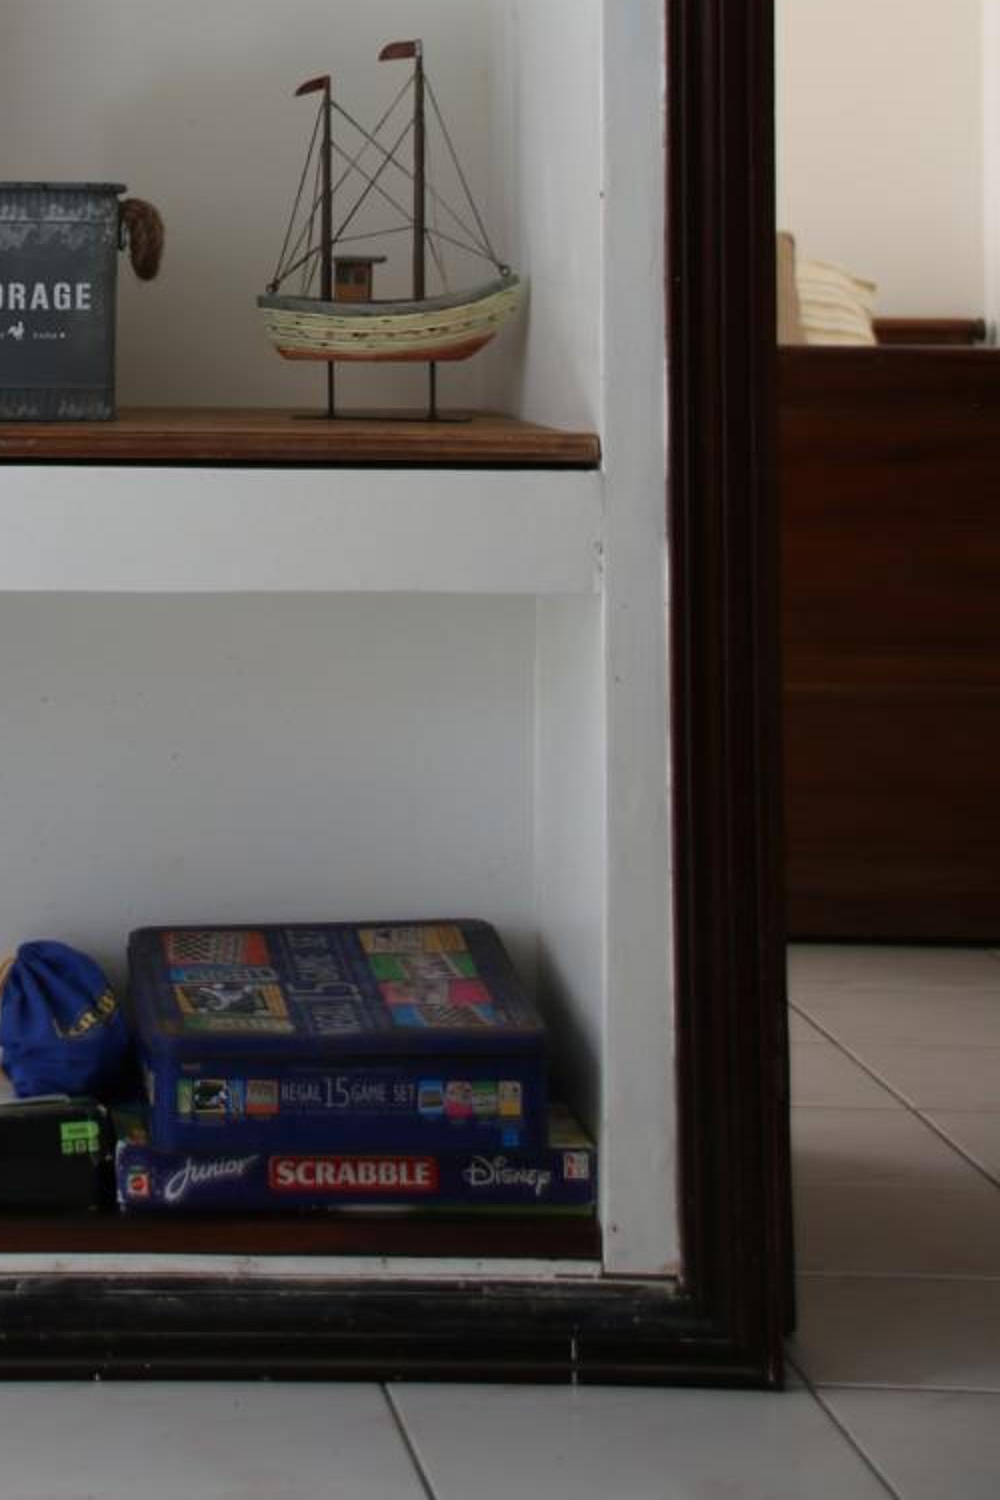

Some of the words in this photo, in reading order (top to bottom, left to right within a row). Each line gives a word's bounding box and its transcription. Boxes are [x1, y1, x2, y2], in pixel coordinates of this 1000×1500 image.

[323, 1076, 350, 1108] 15
[163, 1152, 261, 1201] Junior
[275, 1159, 431, 1187] SCRABBLE
